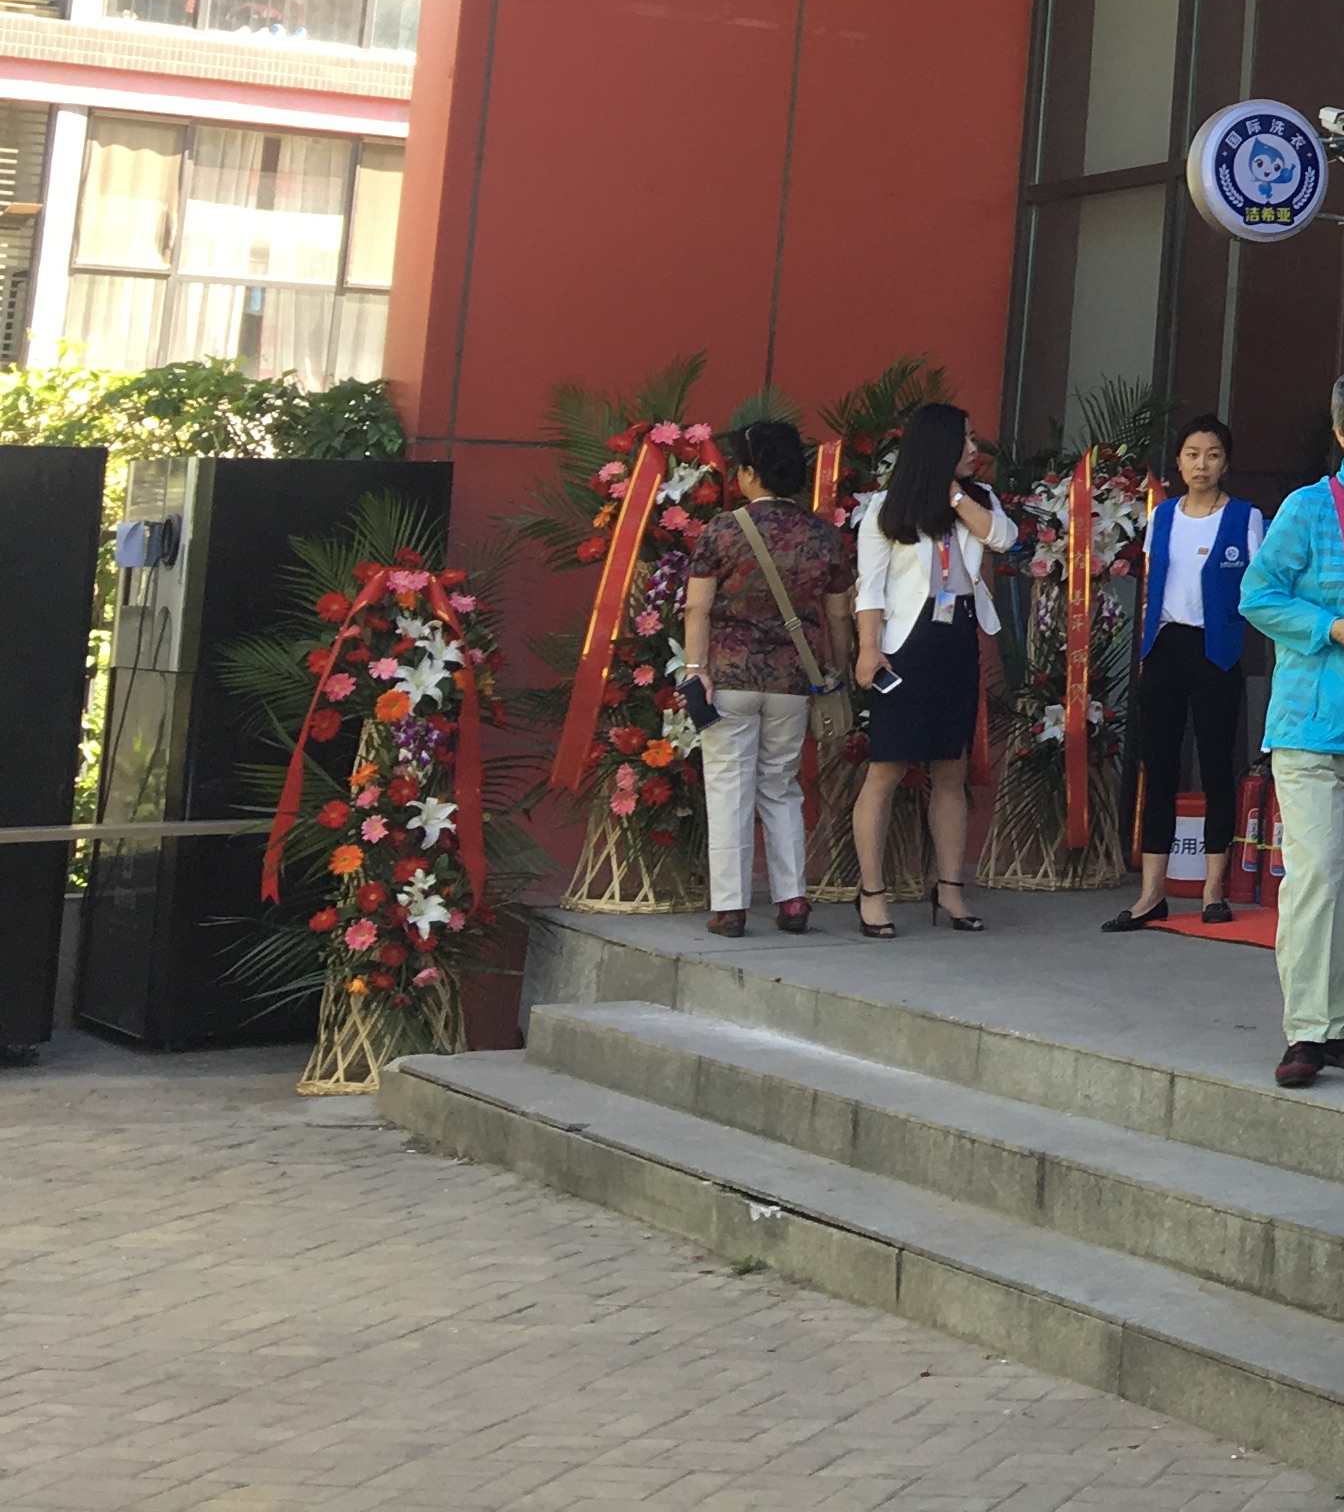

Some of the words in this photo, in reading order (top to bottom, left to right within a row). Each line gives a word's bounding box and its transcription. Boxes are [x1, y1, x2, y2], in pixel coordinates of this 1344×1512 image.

[1225, 118, 1306, 151] 国际洗衣
[1245, 206, 1291, 223] 洁希亚
